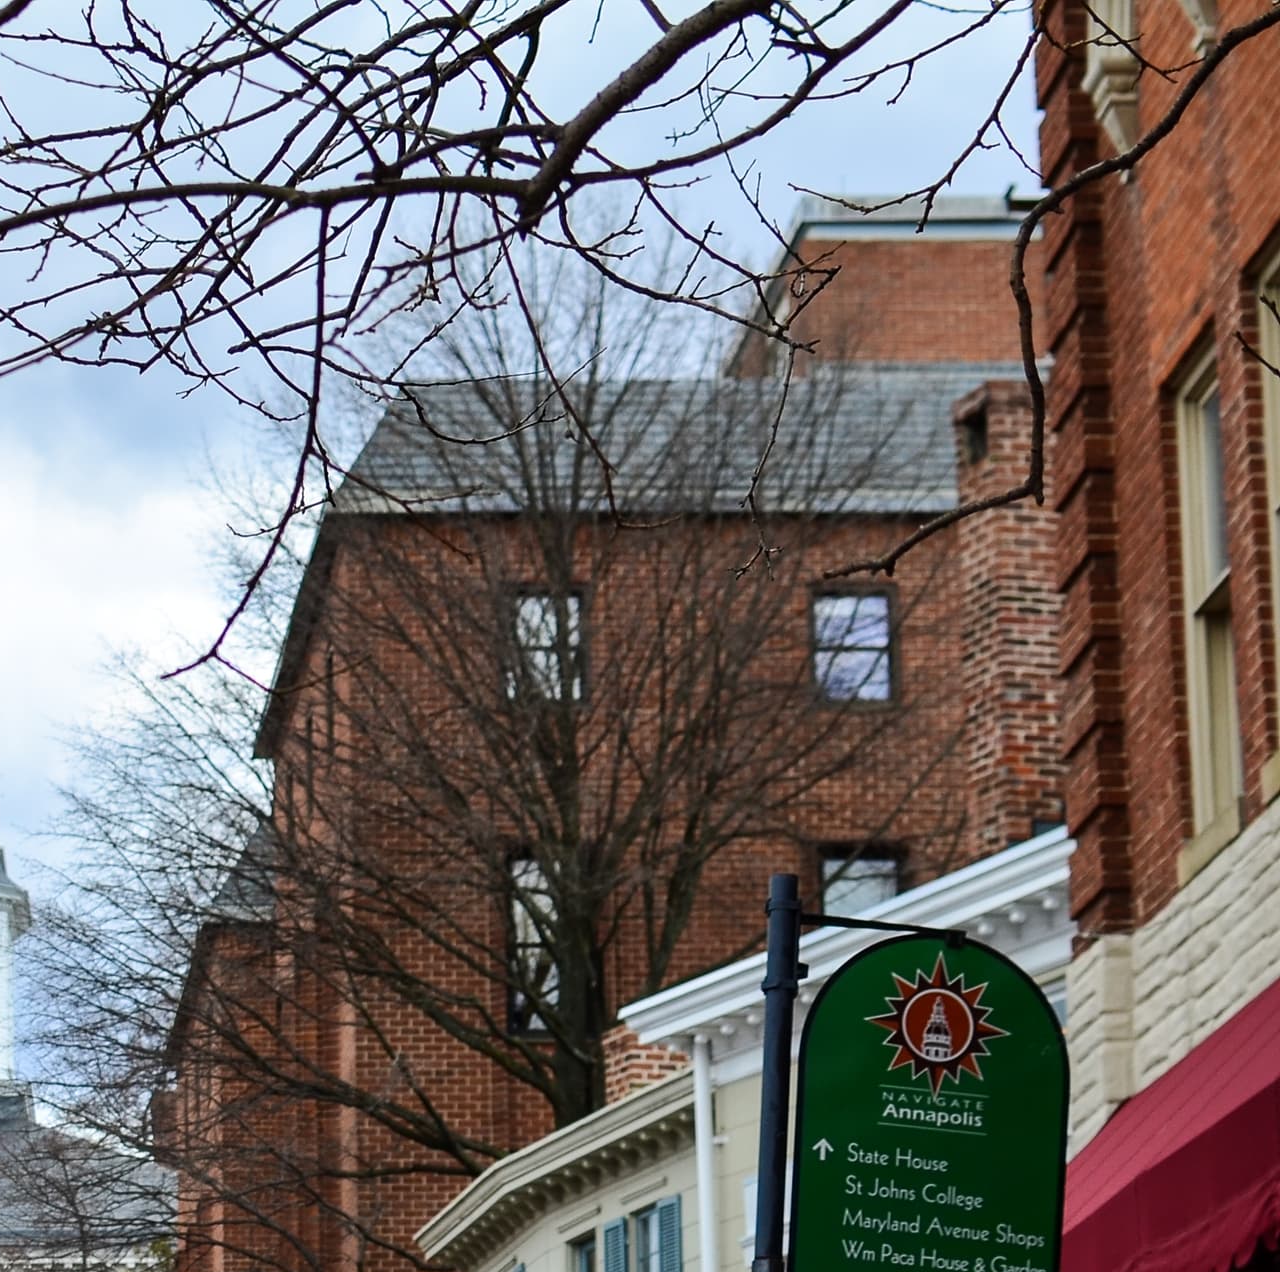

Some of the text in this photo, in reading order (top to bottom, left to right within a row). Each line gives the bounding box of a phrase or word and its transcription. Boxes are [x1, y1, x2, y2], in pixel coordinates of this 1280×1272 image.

[882, 1091, 984, 1111] NAVIGATE
[882, 1103, 983, 1127] Annapolis
[847, 1142, 949, 1172] State House
[845, 1174, 984, 1211] St Johns College
[842, 1208, 1045, 1249] Maryland Avenue Shops
[842, 1239, 876, 1262] Wm
[880, 1243, 915, 1266] Paca
[920, 1248, 969, 1272] House
[973, 1257, 986, 1272] &
